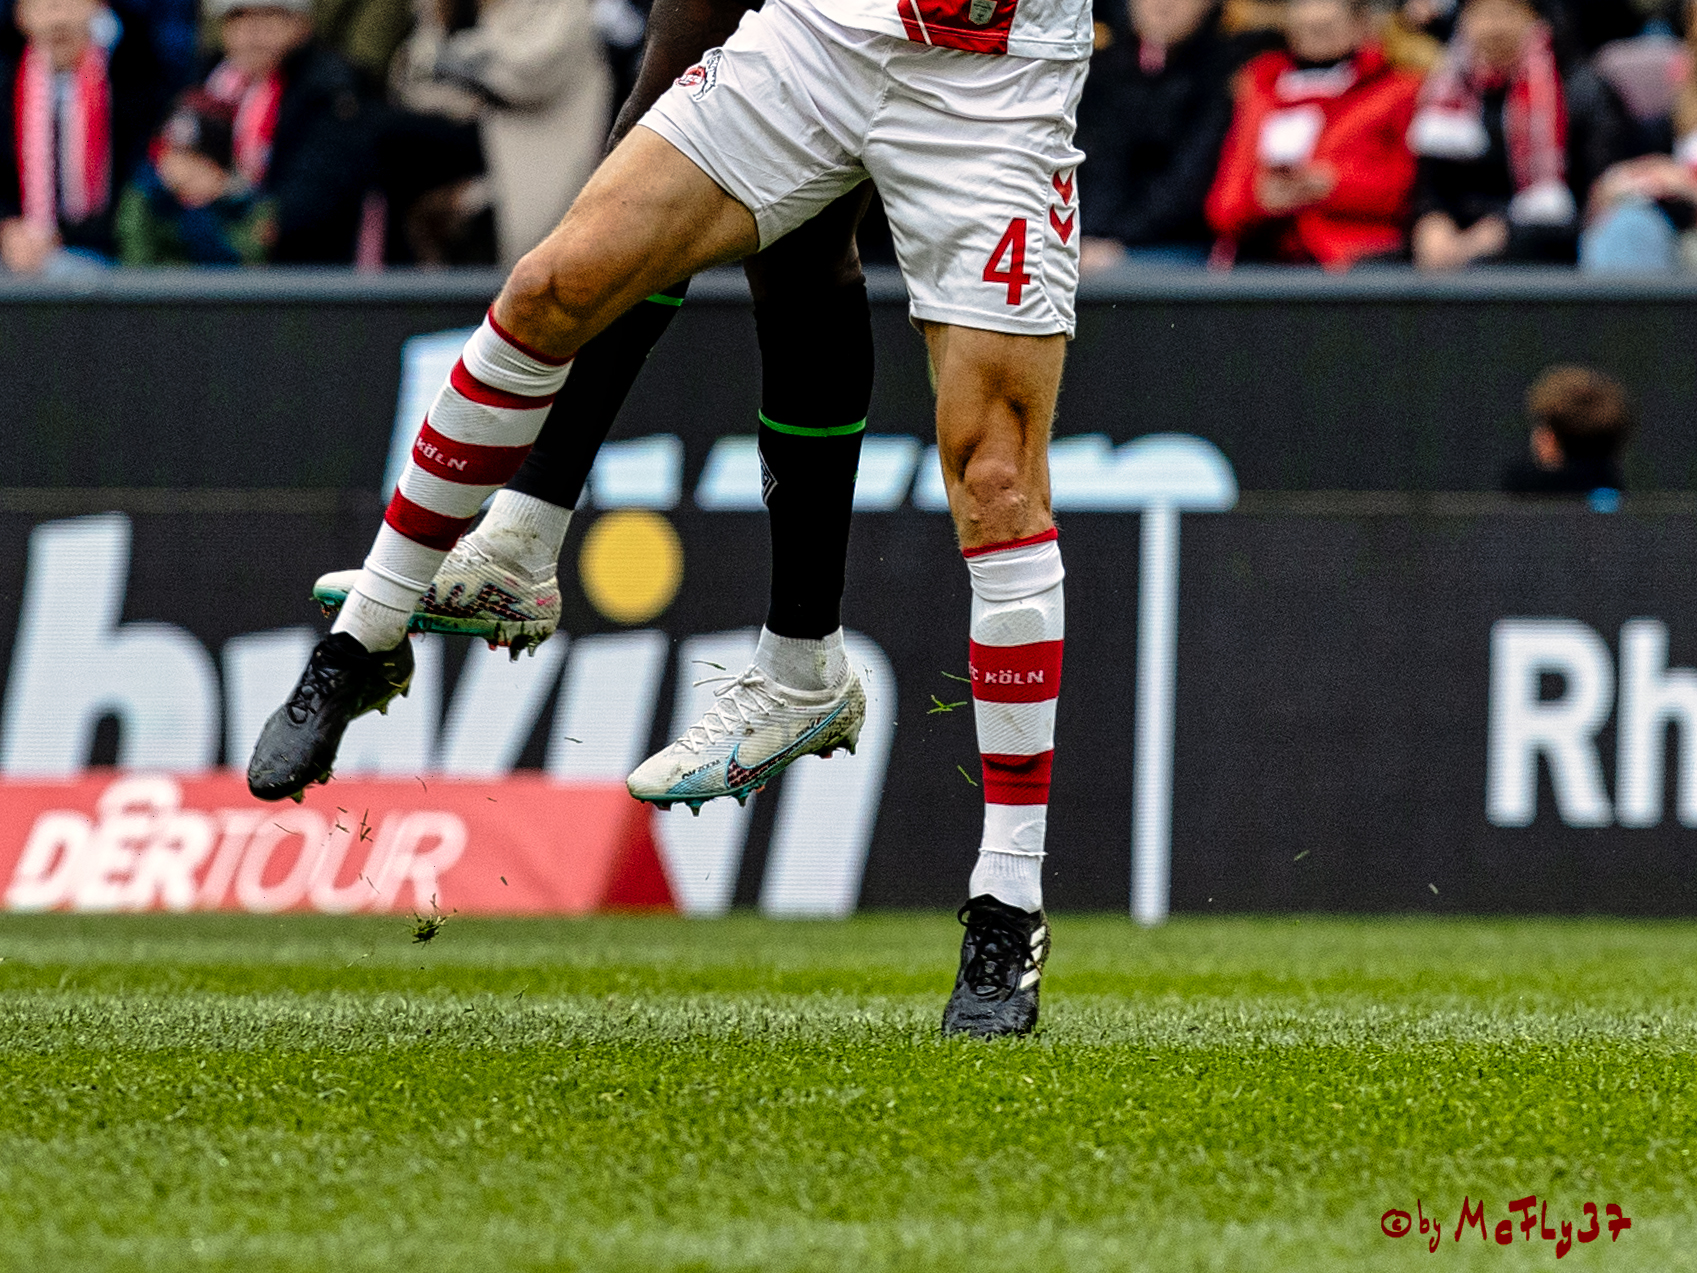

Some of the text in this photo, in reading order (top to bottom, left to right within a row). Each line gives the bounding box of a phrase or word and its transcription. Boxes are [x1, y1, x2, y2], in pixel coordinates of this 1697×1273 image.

[983, 217, 1031, 305] 4
[416, 436, 468, 471] KÖLN
[985, 669, 1044, 685] KÖLN
[6, 782, 469, 913] DERTOUR
